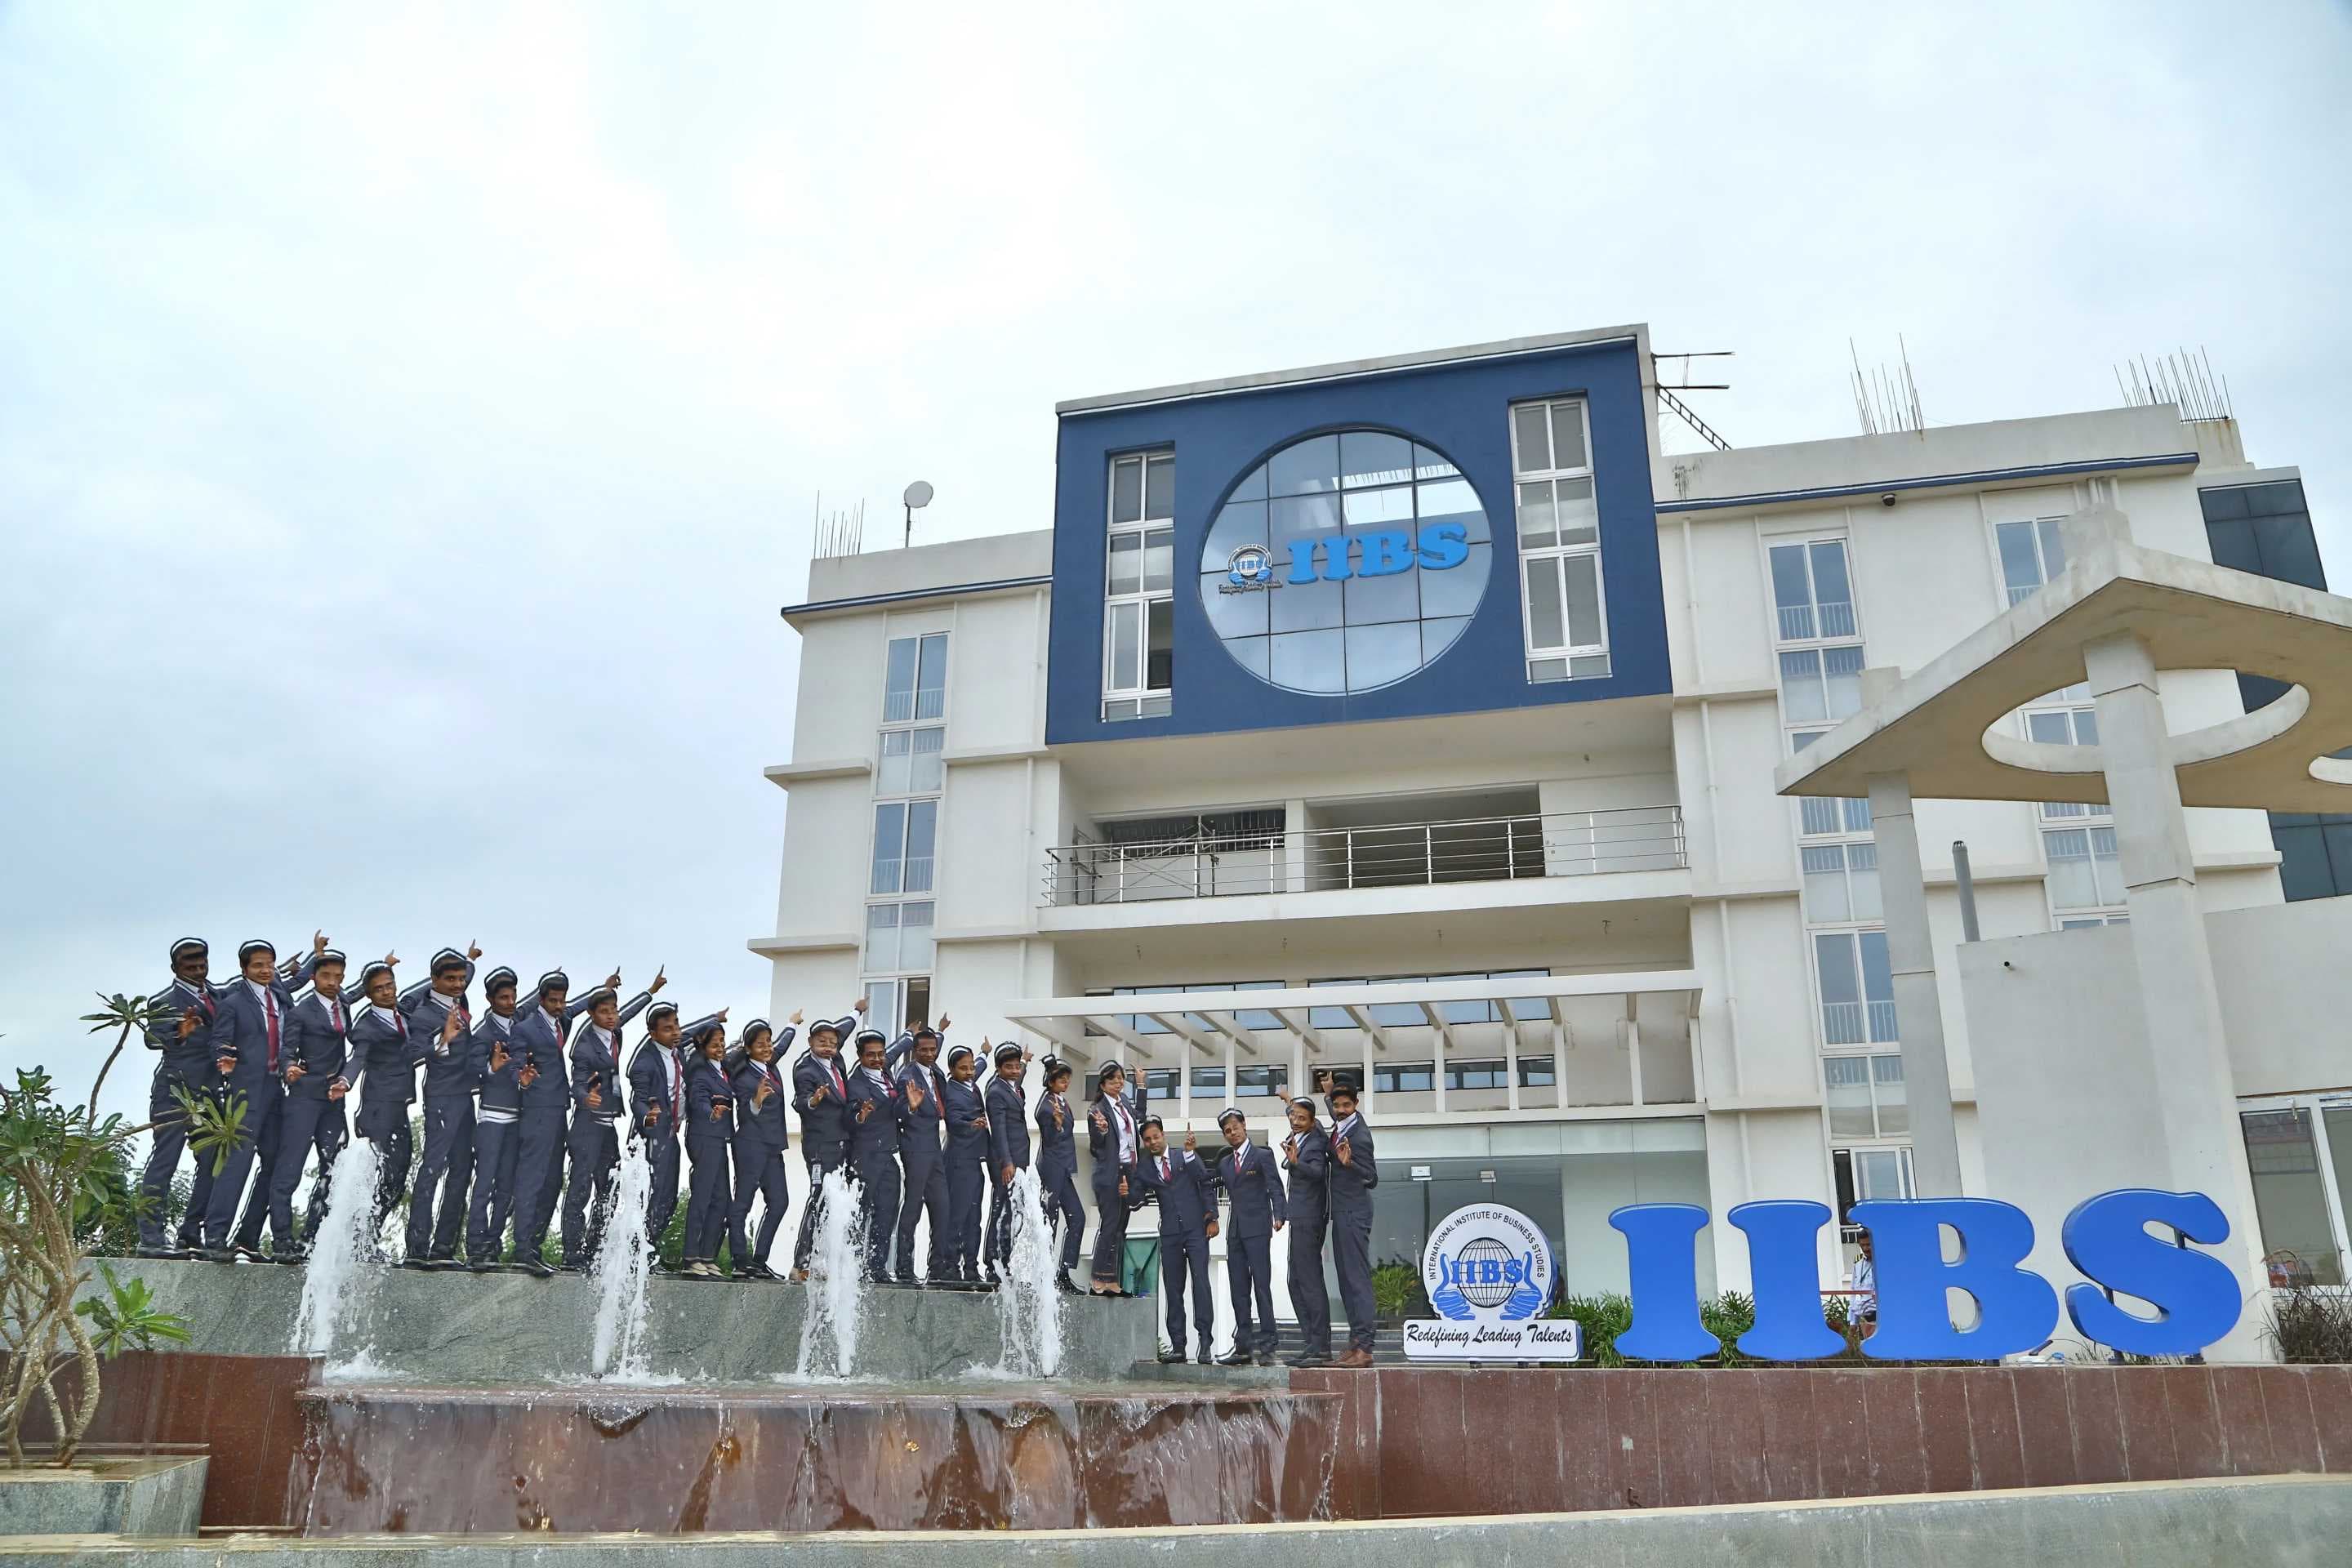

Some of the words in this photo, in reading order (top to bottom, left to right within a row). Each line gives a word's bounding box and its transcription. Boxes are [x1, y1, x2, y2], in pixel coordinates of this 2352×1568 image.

[1288, 523, 1468, 584] IIBS
[1429, 1225, 1455, 1280] INTERNATIONAL
[1454, 1211, 1490, 1226] INSTITUTE
[1492, 1212, 1503, 1220] OF
[1503, 1215, 1535, 1244] BUSINESS
[1532, 1244, 1544, 1278] STUDIES
[1450, 1259, 1523, 1284] IIBS
[1608, 1188, 2243, 1361] IIBS
[1406, 1324, 1470, 1348] Redefining
[1472, 1325, 1522, 1348] Leading
[1527, 1324, 1573, 1343] Talents
